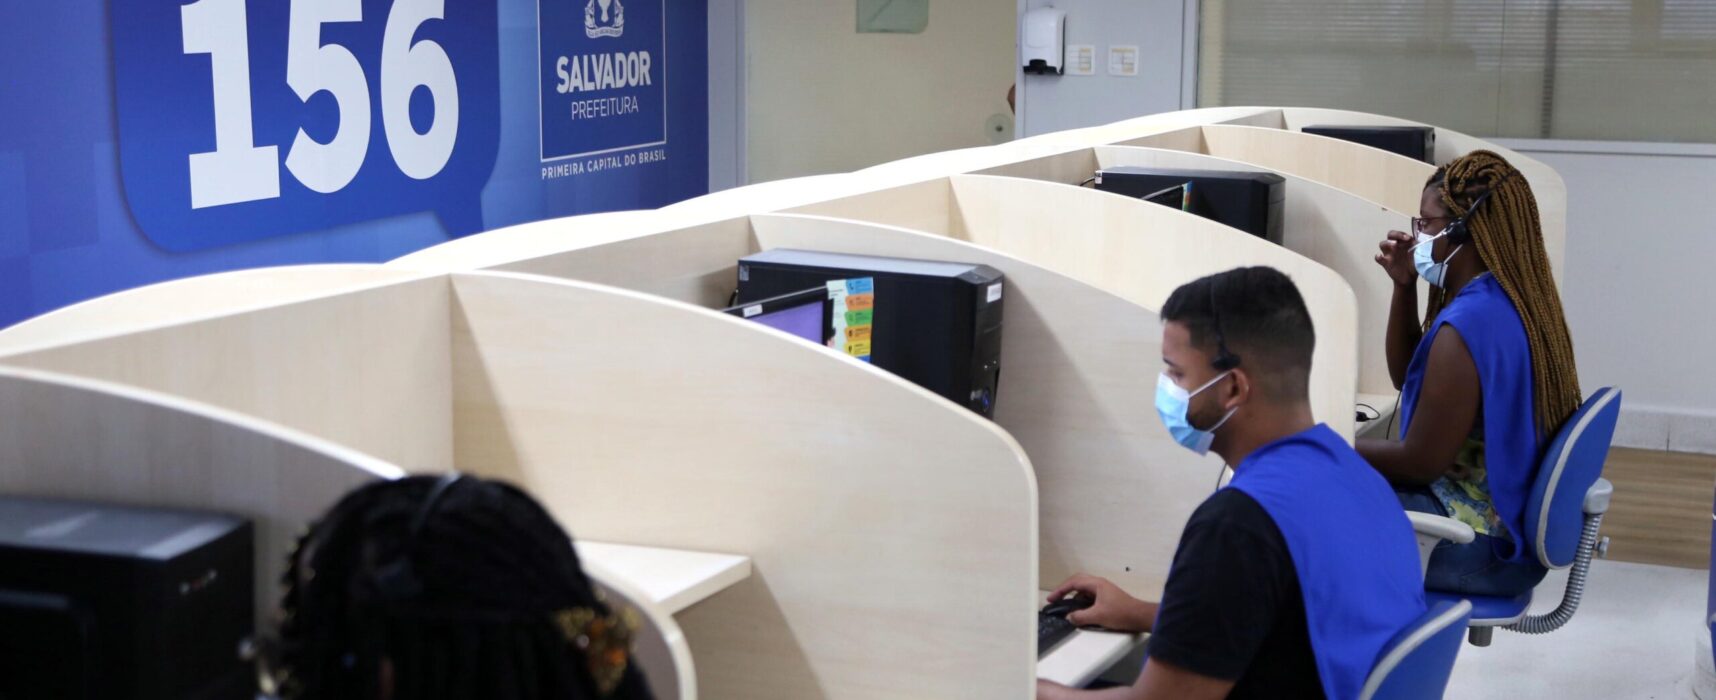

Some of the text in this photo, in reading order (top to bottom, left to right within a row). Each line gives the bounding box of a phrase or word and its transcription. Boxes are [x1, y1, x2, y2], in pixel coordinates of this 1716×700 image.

[556, 51, 652, 94] SALVADOR
[181, 0, 459, 209] 156
[571, 96, 639, 120] PREFEITURA
[541, 150, 666, 179] PRIMEIRA CAPITAL DO BRASIL
